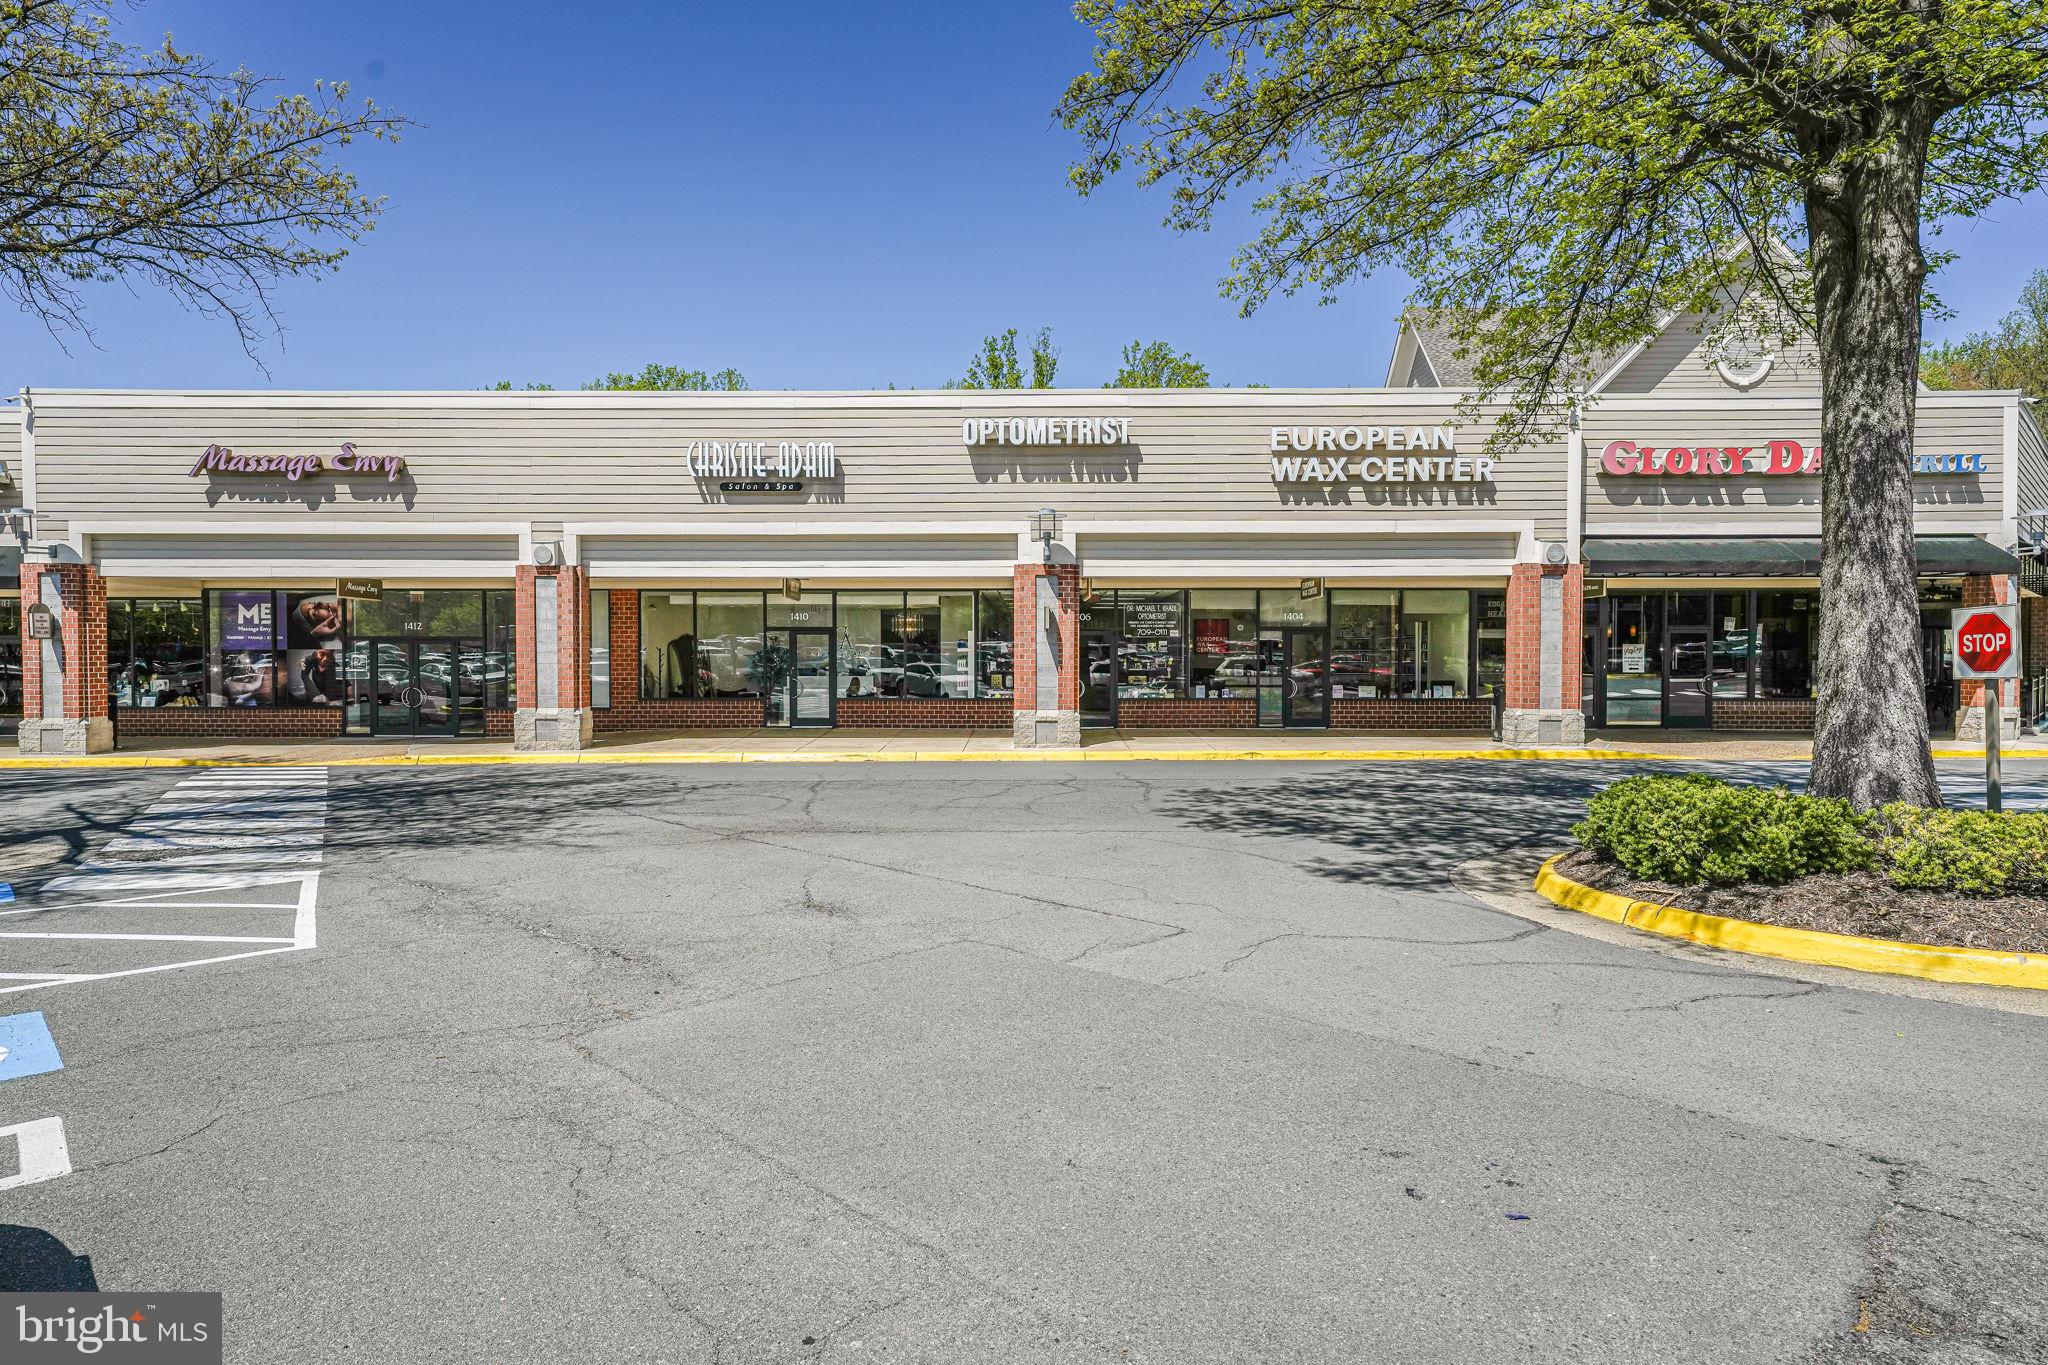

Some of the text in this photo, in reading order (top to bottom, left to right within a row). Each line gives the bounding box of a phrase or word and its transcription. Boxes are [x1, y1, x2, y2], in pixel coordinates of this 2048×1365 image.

[962, 417, 1132, 445] OPTOMETRIST
[1271, 426, 1454, 450] EUROPEAN
[188, 442, 404, 482] Massage Envy
[686, 441, 835, 477] CHRISTIE-ADAM
[1600, 440, 1822, 475] GLORY DA
[1271, 457, 1495, 482] WAX CENTER
[728, 482, 794, 491] Salon & Spa
[238, 603, 272, 624] ME
[790, 613, 809, 621] 1410
[1080, 613, 1091, 621] 06
[1284, 612, 1304, 620] 1404
[404, 622, 422, 630] 1412
[1963, 633, 2007, 652] STOP
